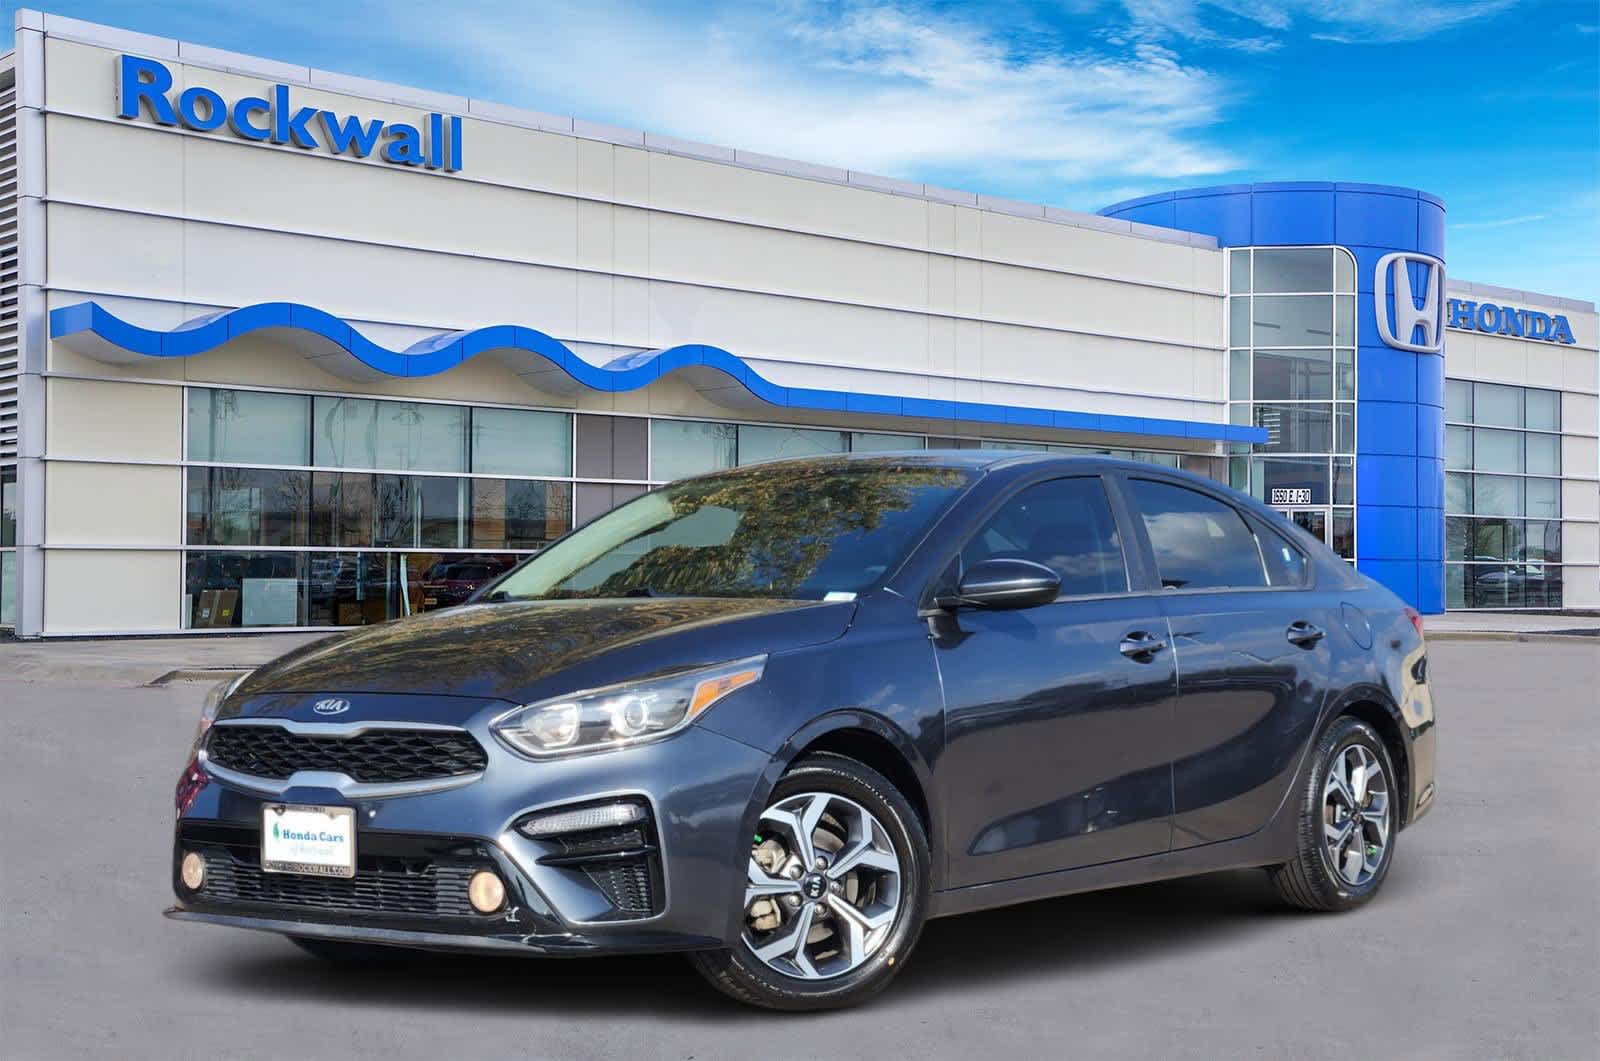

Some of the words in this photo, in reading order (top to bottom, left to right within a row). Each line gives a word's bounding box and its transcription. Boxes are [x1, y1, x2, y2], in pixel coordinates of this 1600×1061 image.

[118, 54, 463, 173] Rockwall
[1447, 298, 1577, 345] HONDA
[314, 699, 346, 711] KIA
[283, 828, 318, 841] Honda
[319, 831, 345, 842] Cars
